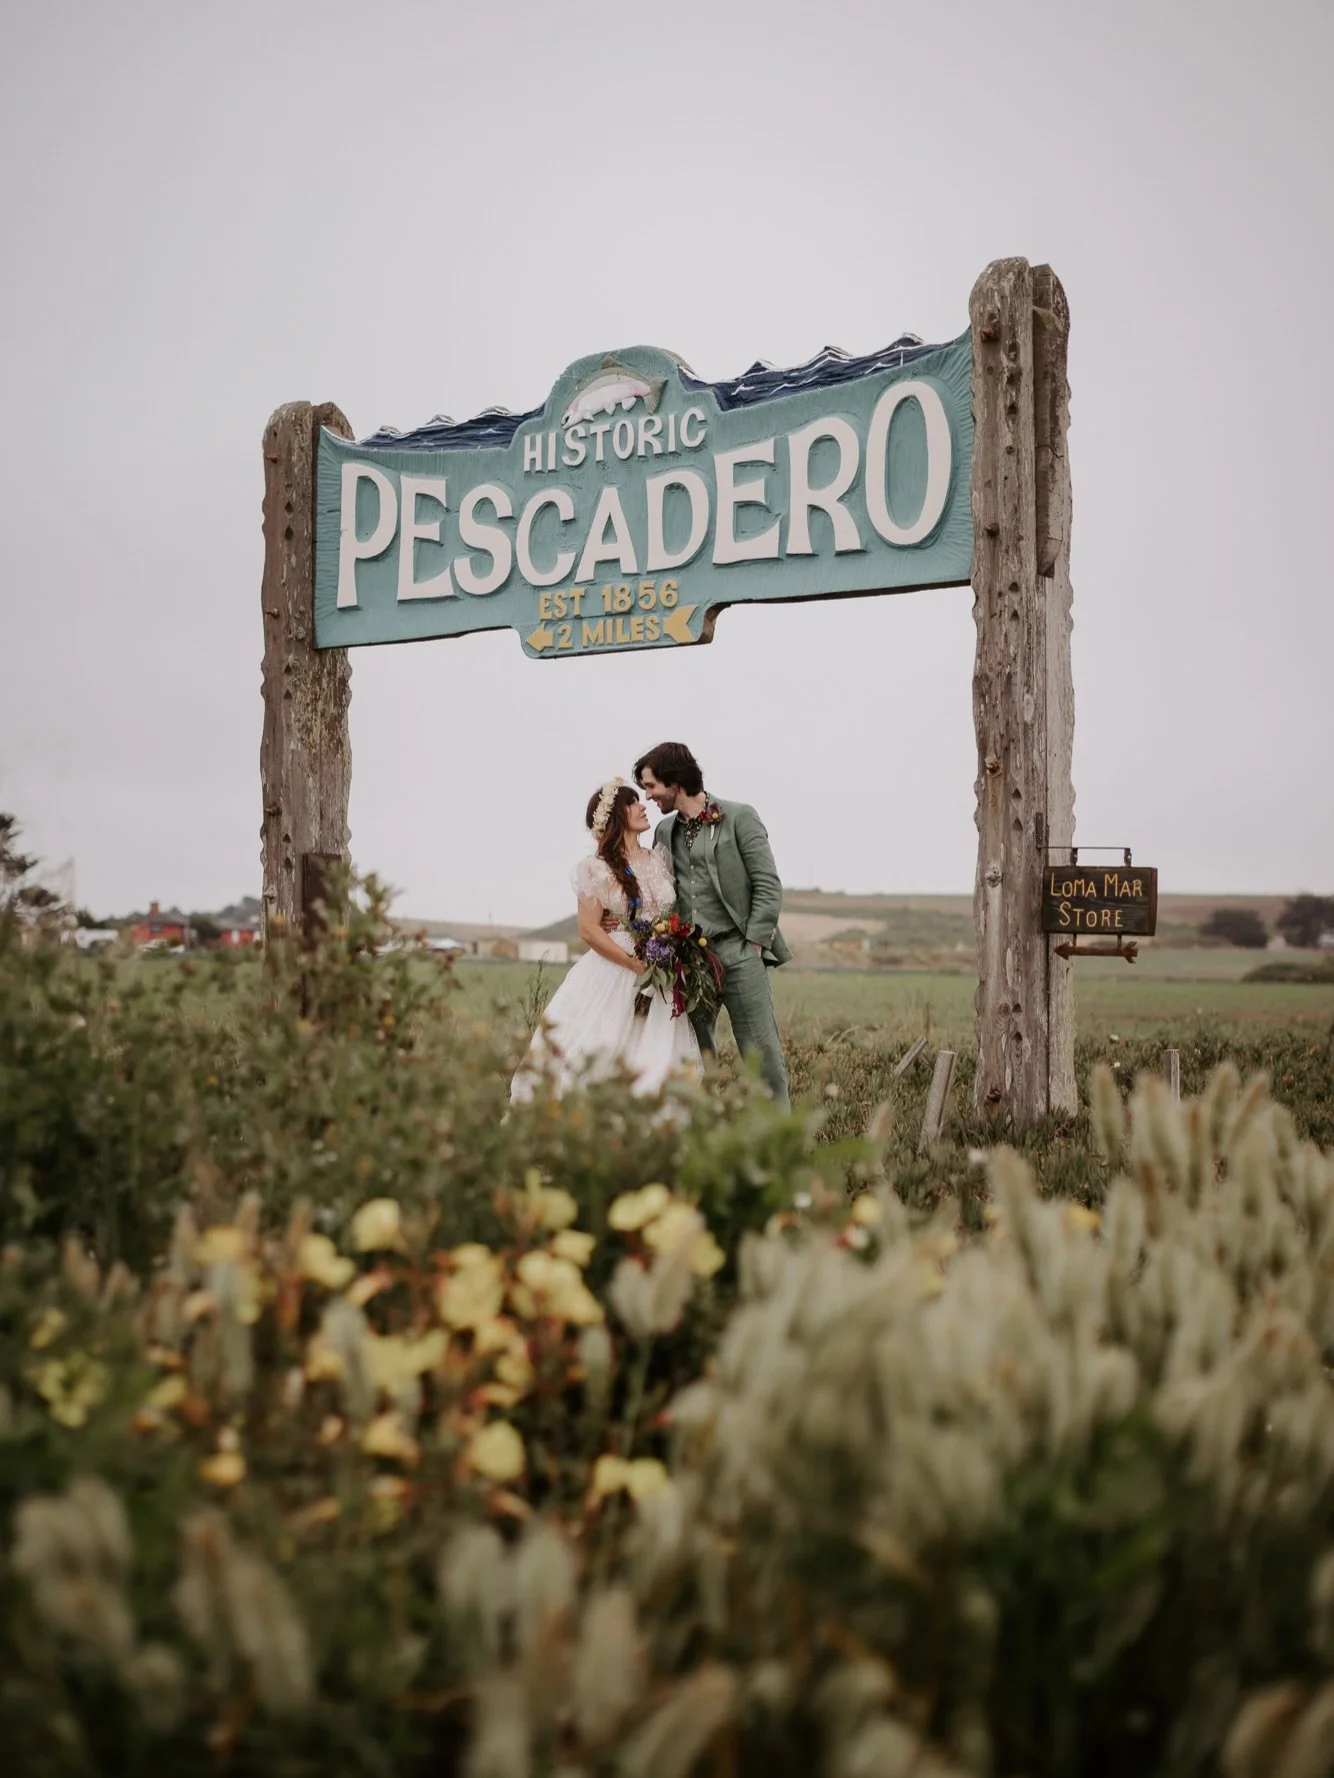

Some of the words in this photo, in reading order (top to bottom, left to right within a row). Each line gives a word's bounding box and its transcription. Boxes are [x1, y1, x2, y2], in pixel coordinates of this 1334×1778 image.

[523, 407, 708, 472] HISTORIC
[336, 380, 952, 609] PESCADERO
[540, 587, 587, 621] EST
[602, 579, 680, 614] 1856
[557, 624, 573, 649] 2
[582, 615, 660, 648] MILES
[1050, 872, 1097, 898] LOMA
[1104, 873, 1143, 897] MAR
[1059, 901, 1124, 928] STORE
